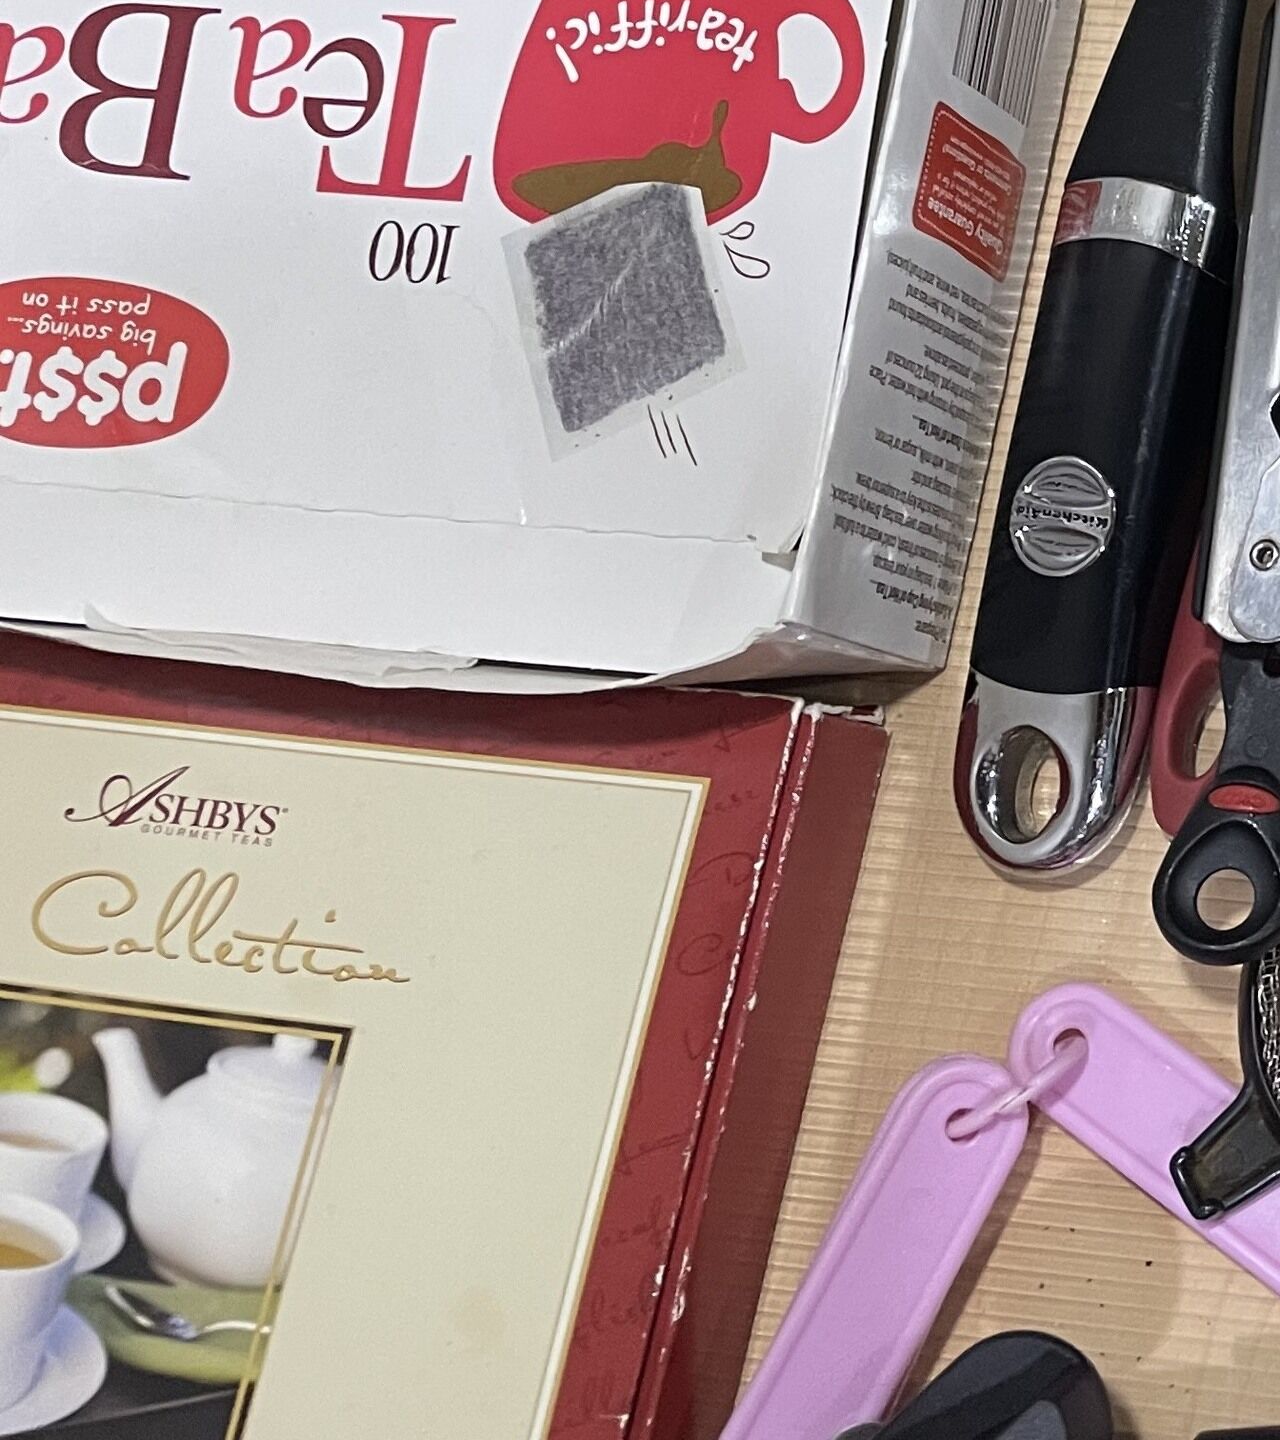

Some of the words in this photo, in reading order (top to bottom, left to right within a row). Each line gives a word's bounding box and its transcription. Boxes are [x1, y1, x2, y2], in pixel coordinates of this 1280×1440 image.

[228, 13, 474, 203] Tea
[925, 195, 975, 237] Guarantee
[368, 220, 461, 285] 100
[21, 291, 49, 307] on
[55, 295, 79, 317] it
[85, 292, 152, 316] pass
[119, 320, 157, 357] big
[1015, 505, 1110, 530] KitchenAid
[139, 823, 222, 843] GOURMET
[230, 831, 274, 848] TEAS
[30, 866, 412, 985] Collection
